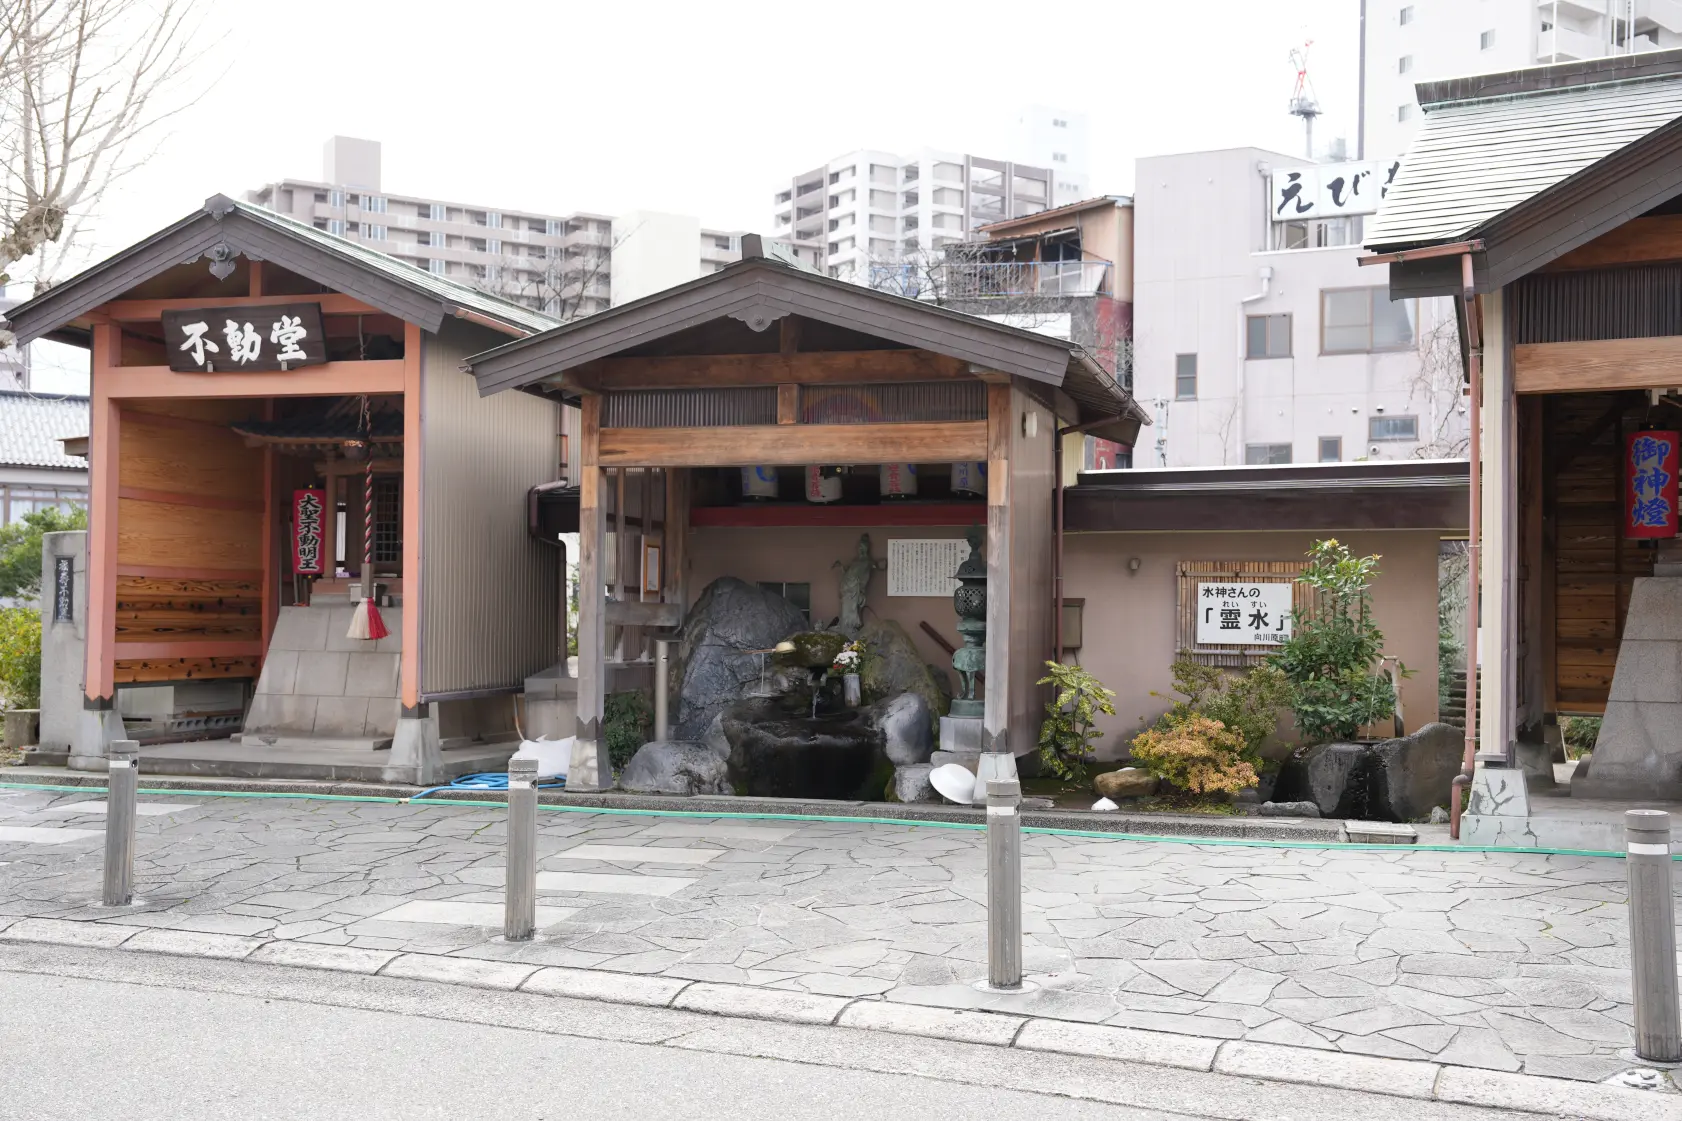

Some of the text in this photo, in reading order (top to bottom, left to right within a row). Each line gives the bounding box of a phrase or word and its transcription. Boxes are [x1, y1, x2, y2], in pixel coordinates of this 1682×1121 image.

[180, 315, 307, 366] 不動堂
[1632, 436, 1671, 527] 御神燈
[298, 493, 322, 571] 大聖不動明王
[1202, 586, 1261, 598] 水神さんの
[1222, 600, 1267, 608] れい すい
